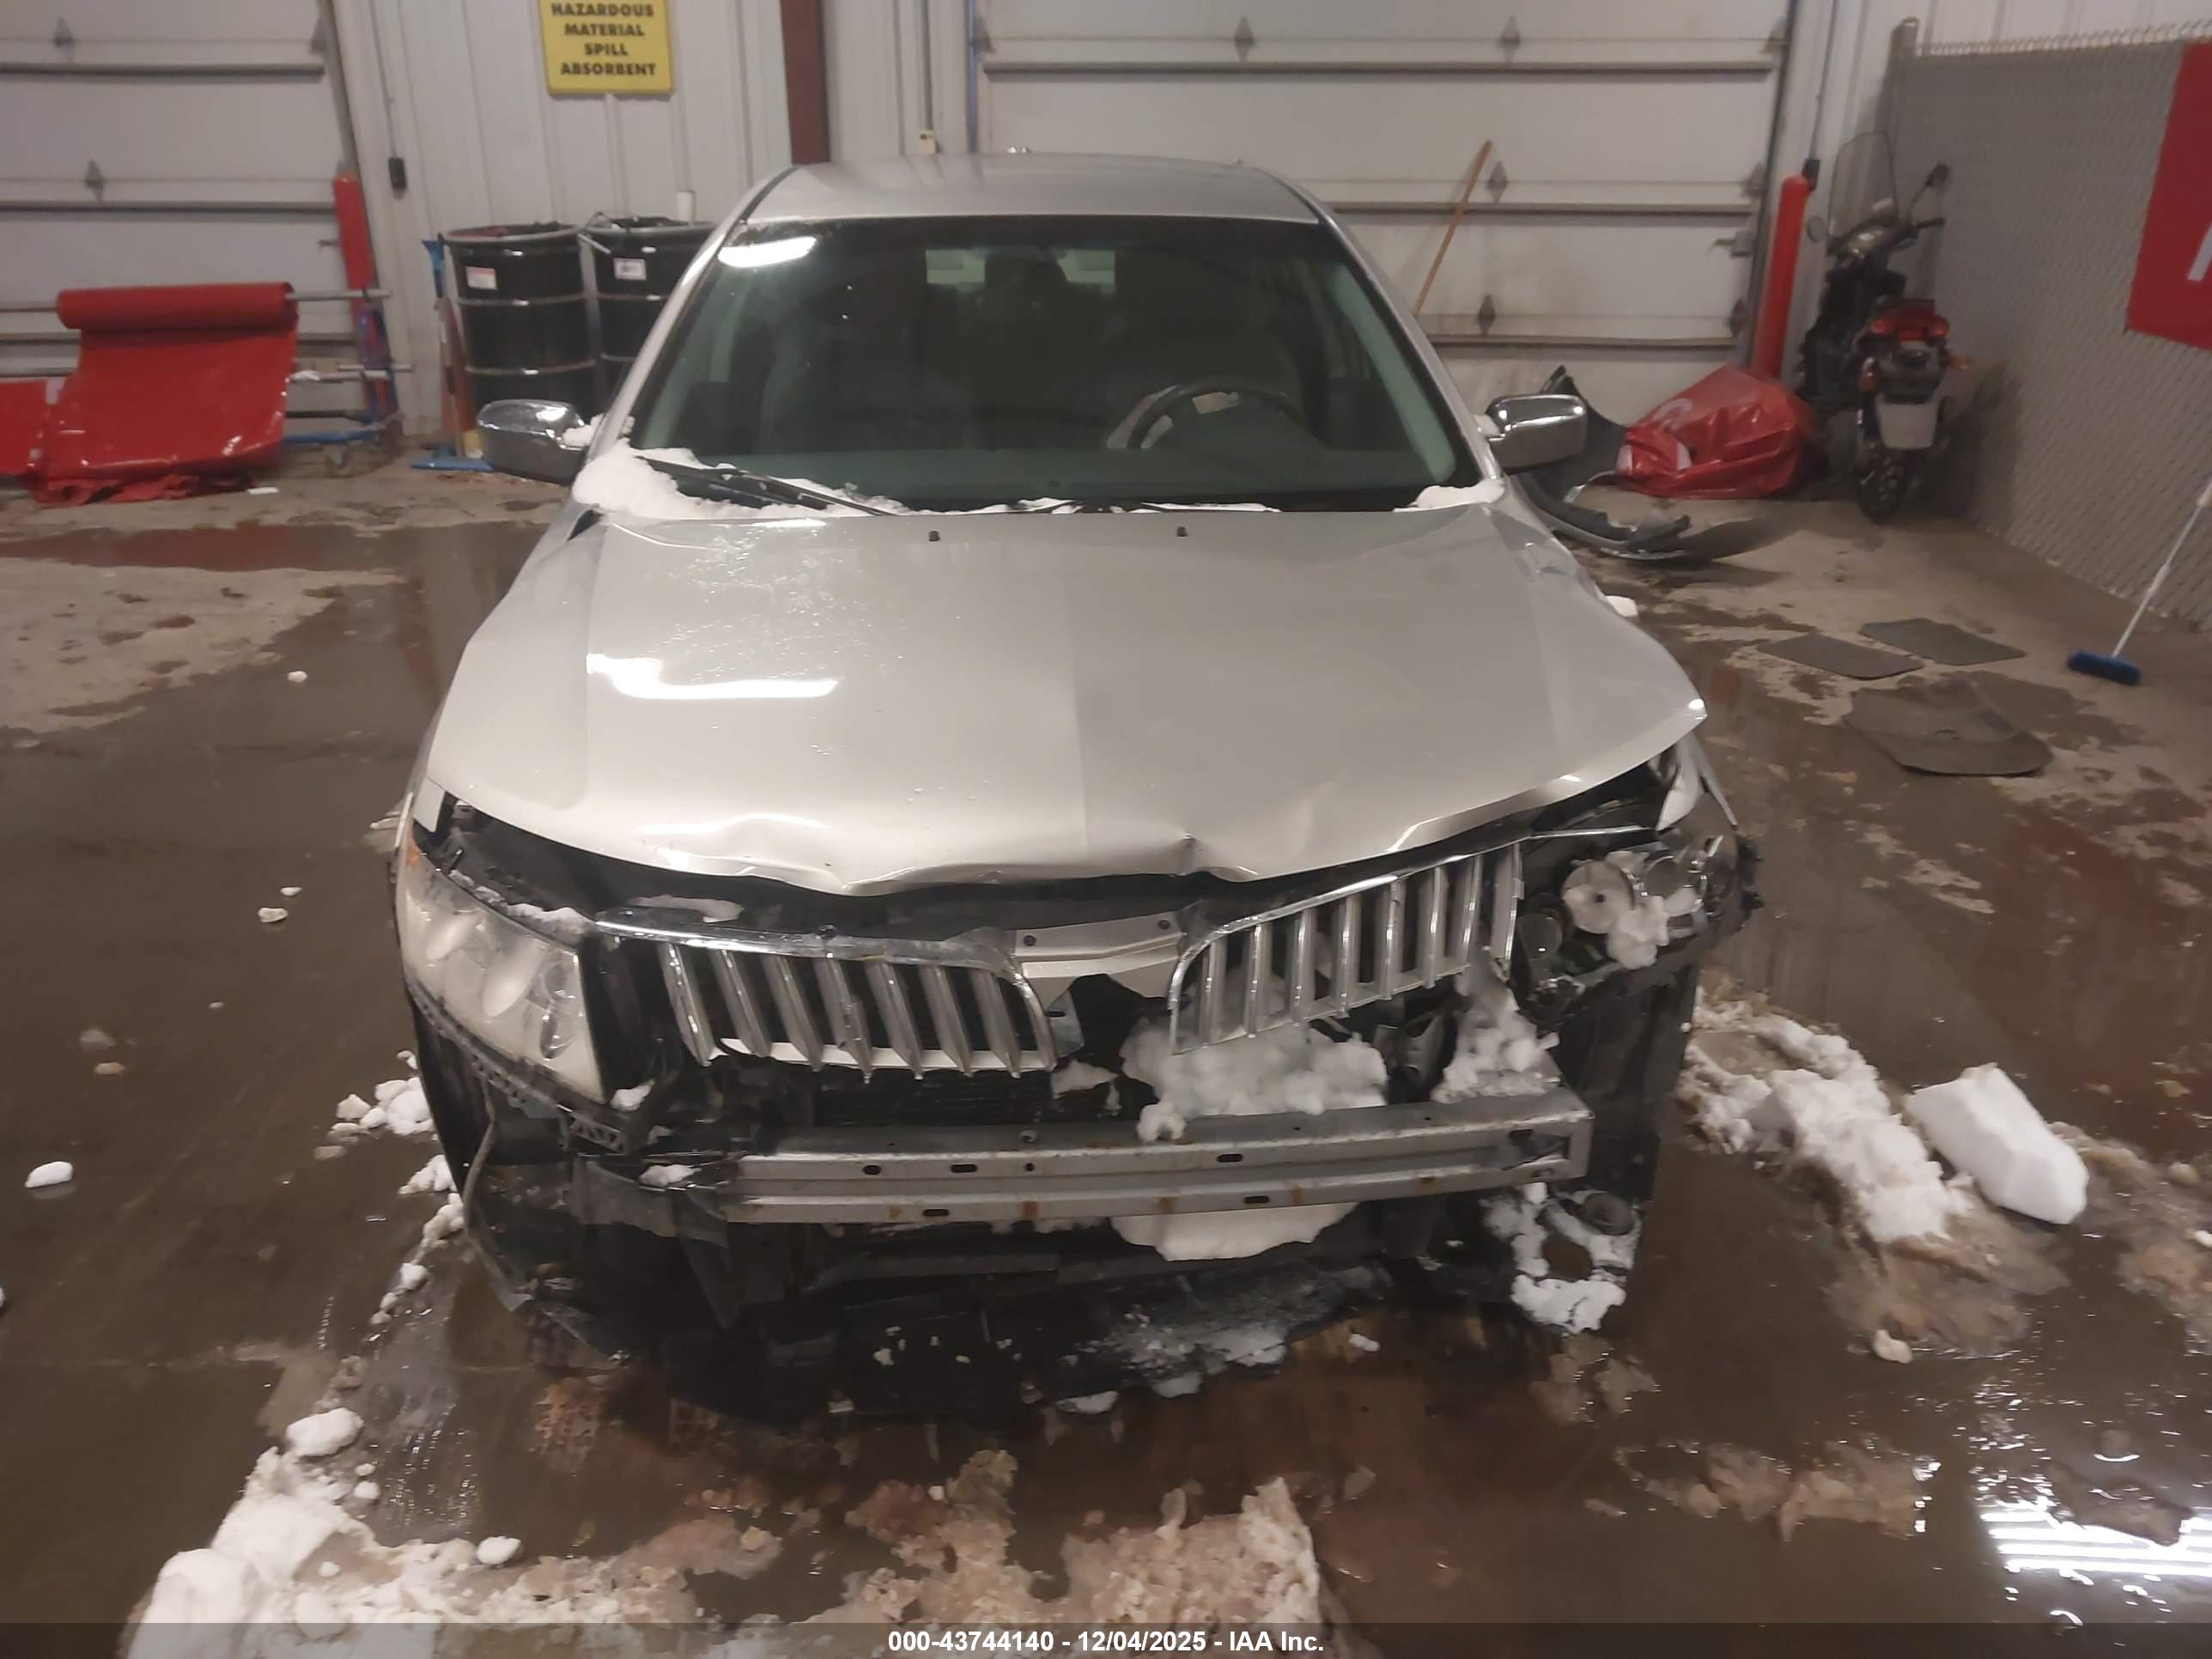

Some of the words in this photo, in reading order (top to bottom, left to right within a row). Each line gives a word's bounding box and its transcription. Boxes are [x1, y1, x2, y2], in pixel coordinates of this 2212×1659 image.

[551, 3, 653, 16] HAZARDOUS
[564, 23, 645, 36] MATERIAL
[585, 43, 629, 56] SPILL
[561, 63, 656, 76] ABSORBENT
